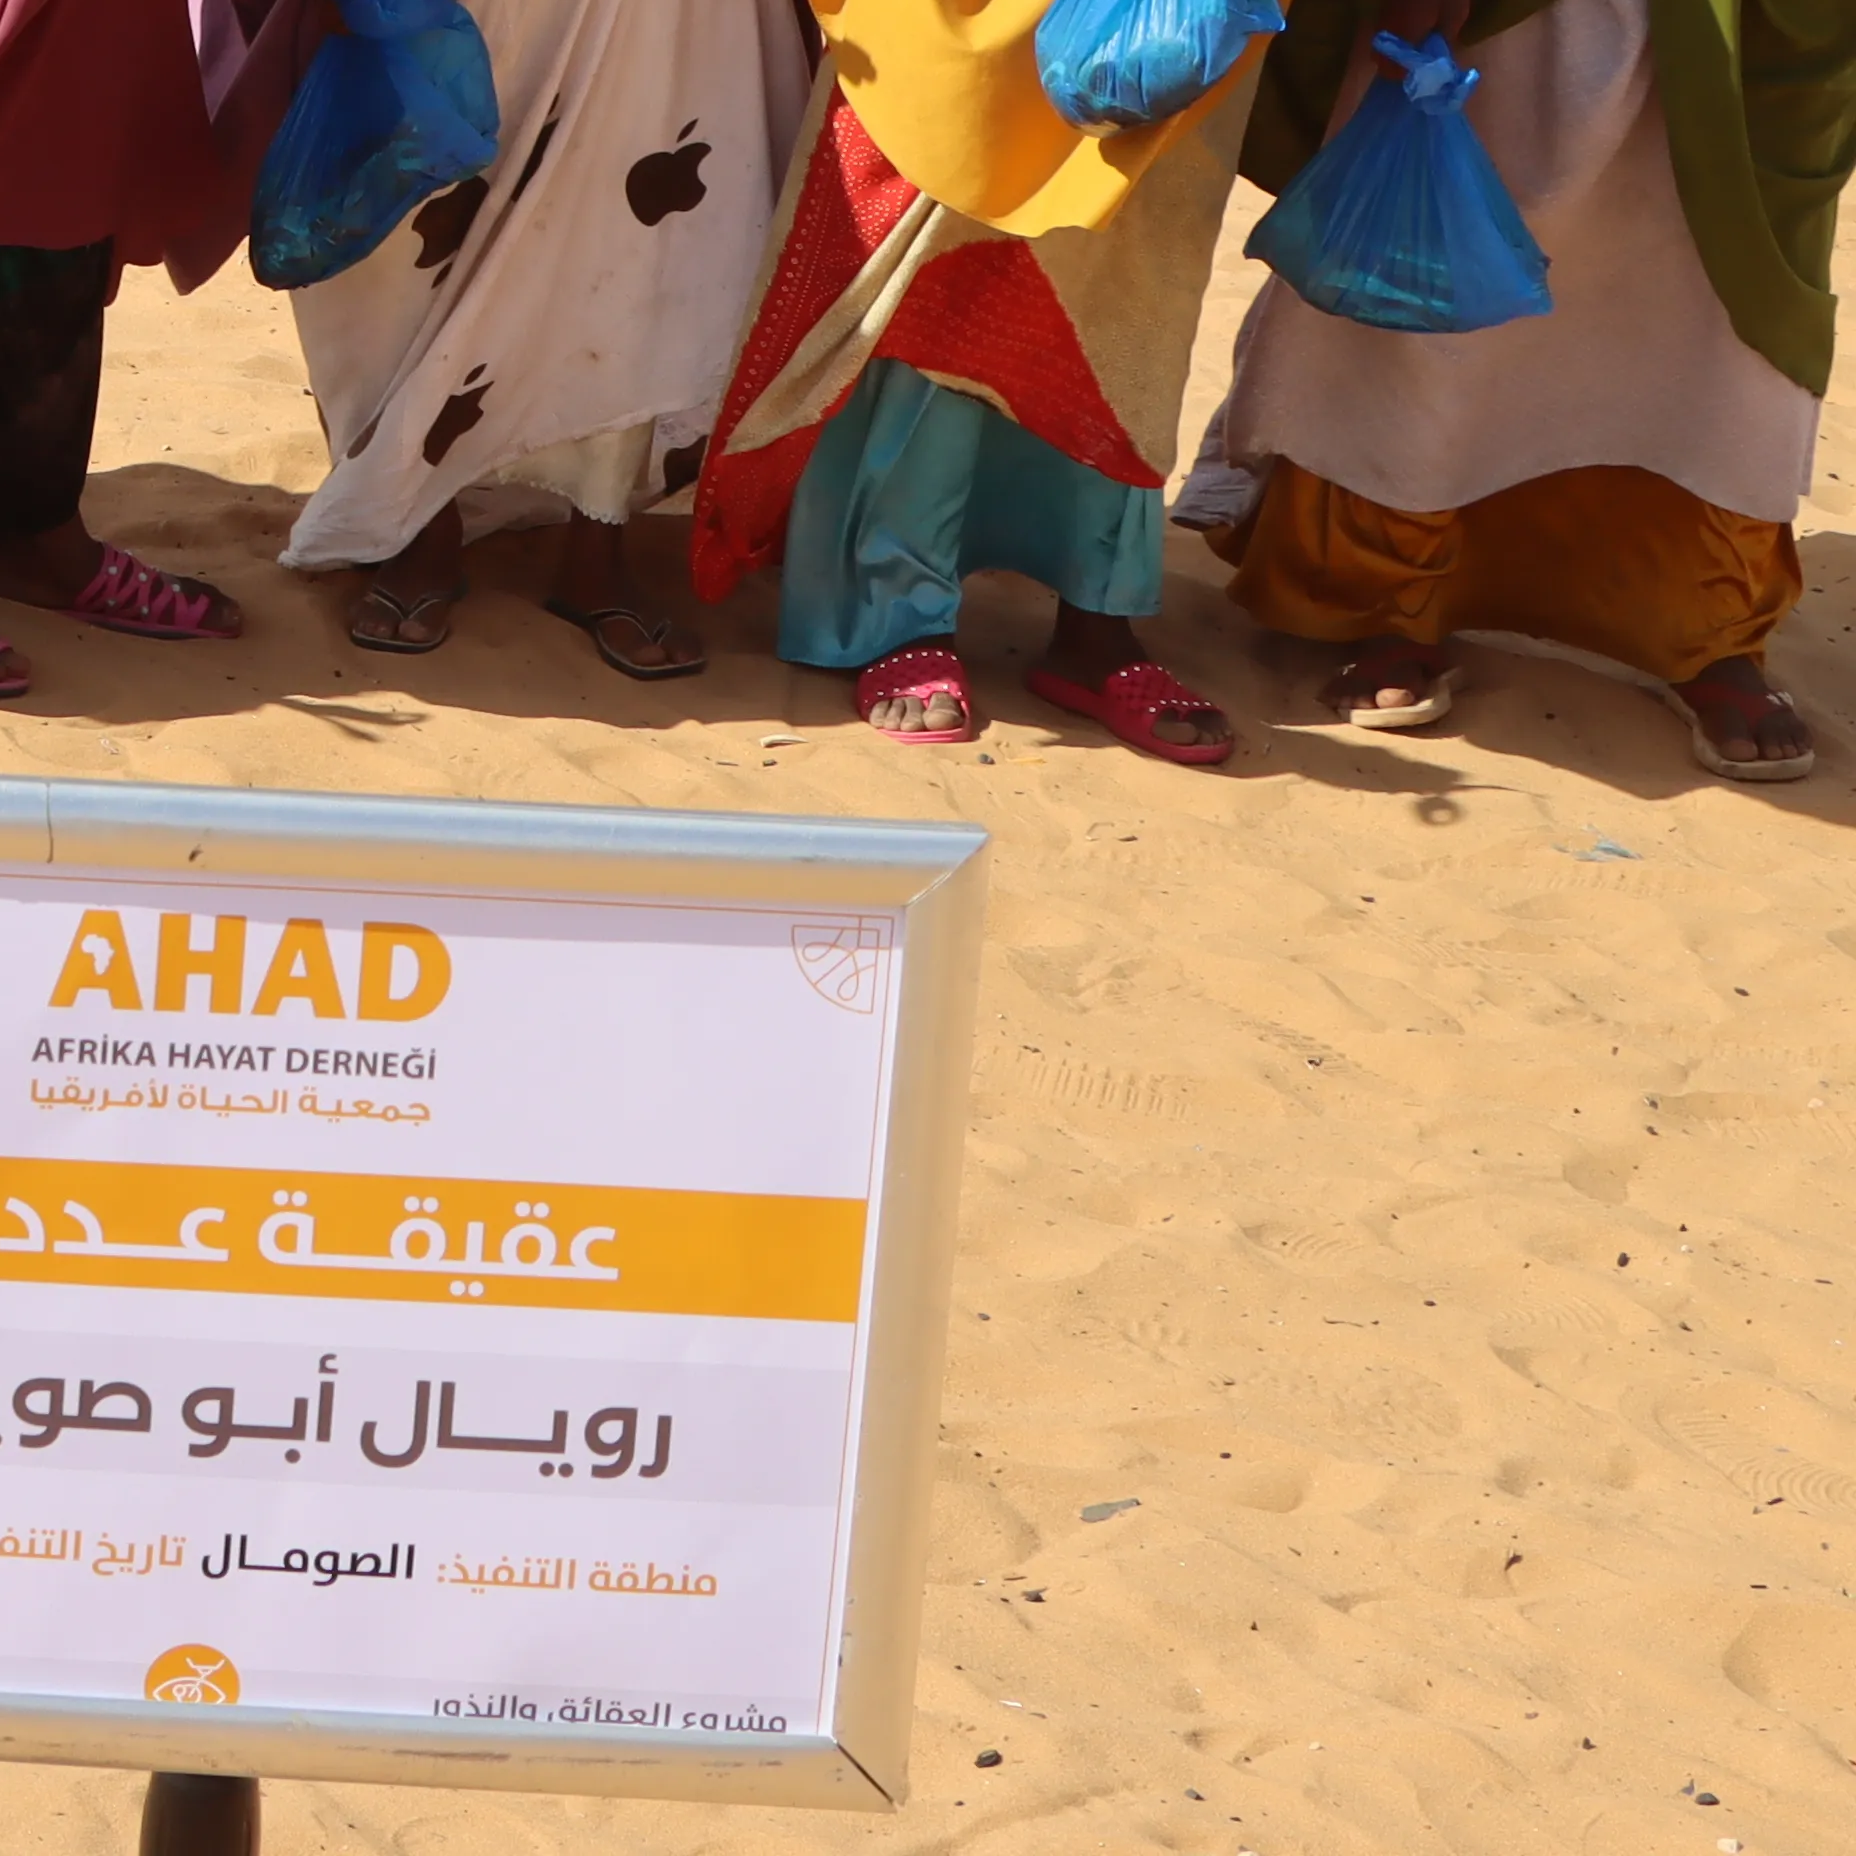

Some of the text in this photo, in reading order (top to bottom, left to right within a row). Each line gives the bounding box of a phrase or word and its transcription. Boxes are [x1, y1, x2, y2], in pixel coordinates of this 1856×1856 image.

[47, 909, 452, 1022] AHAD
[31, 1034, 437, 1080] AFRİKA HAYAT DERNEĞİ
[29, 1076, 431, 1126] جمعية الحياة لأفريقيا
[257, 1189, 619, 1298] عقيقة
[180, 1353, 339, 1464] أبو
[360, 1379, 673, 1480] رويال
[91, 1532, 186, 1576] تاريخ
[201, 1533, 416, 1587] الصومال
[436, 1553, 577, 1594] التنفيذ:
[588, 1560, 718, 1597] منطقة
